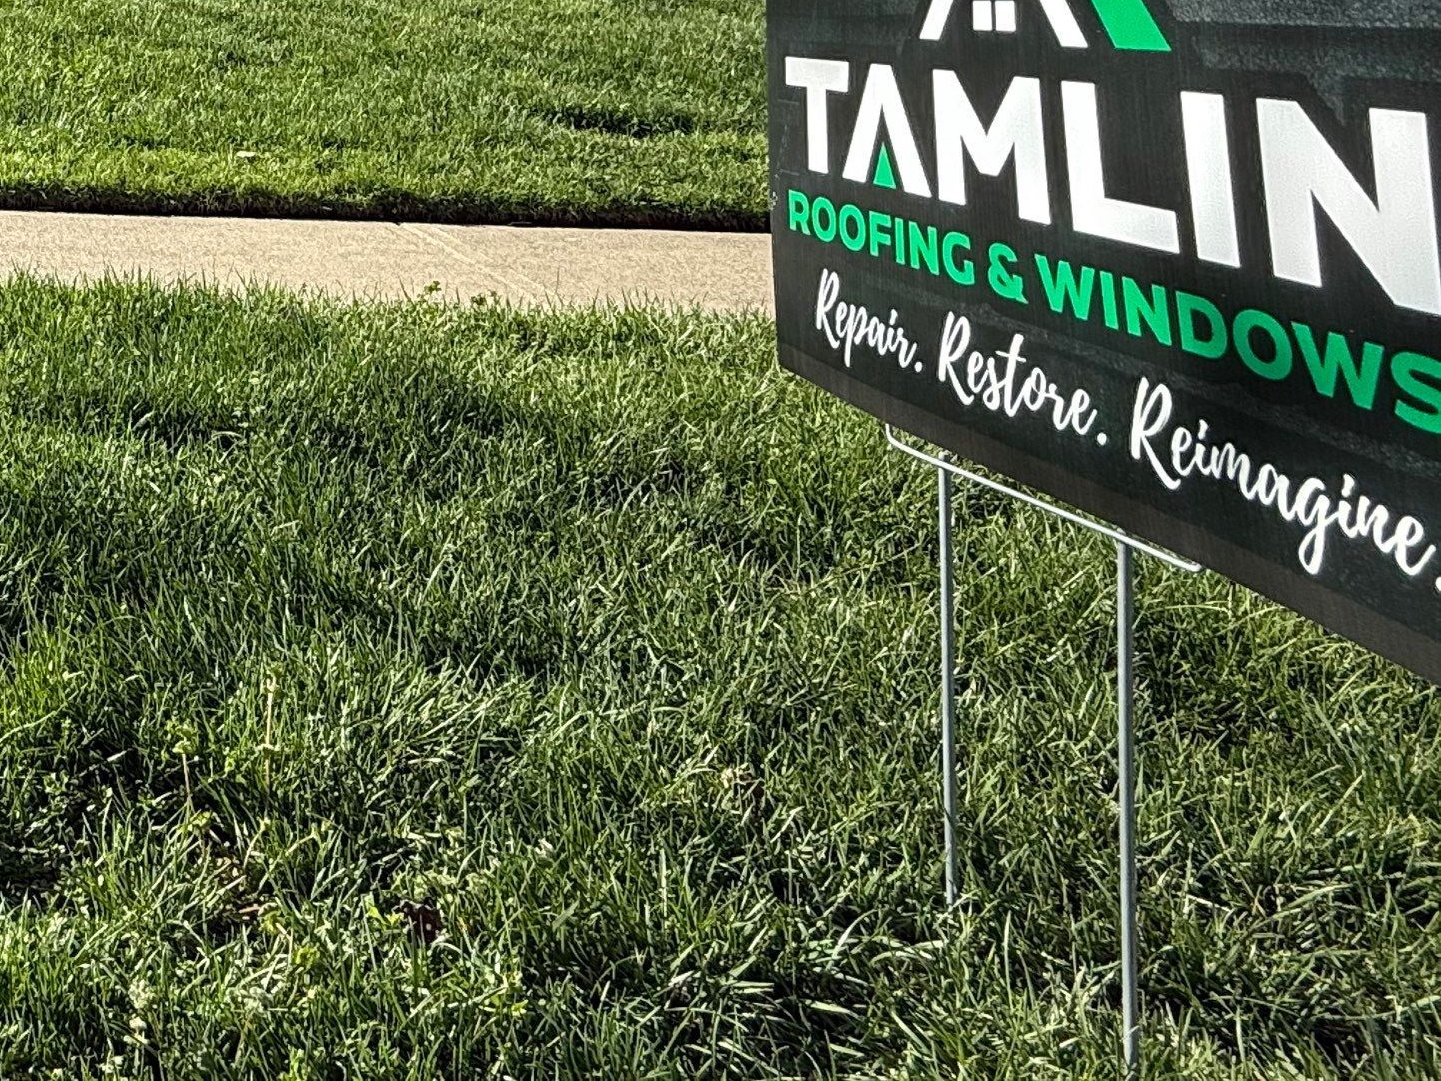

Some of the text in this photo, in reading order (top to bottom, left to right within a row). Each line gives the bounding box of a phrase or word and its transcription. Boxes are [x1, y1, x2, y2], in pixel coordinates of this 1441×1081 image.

[784, 55, 1441, 316] TAMLIN
[787, 189, 1441, 435] ROOFING & WINDOWS
[815, 268, 923, 369] Repair.
[937, 310, 1108, 446] Restore.
